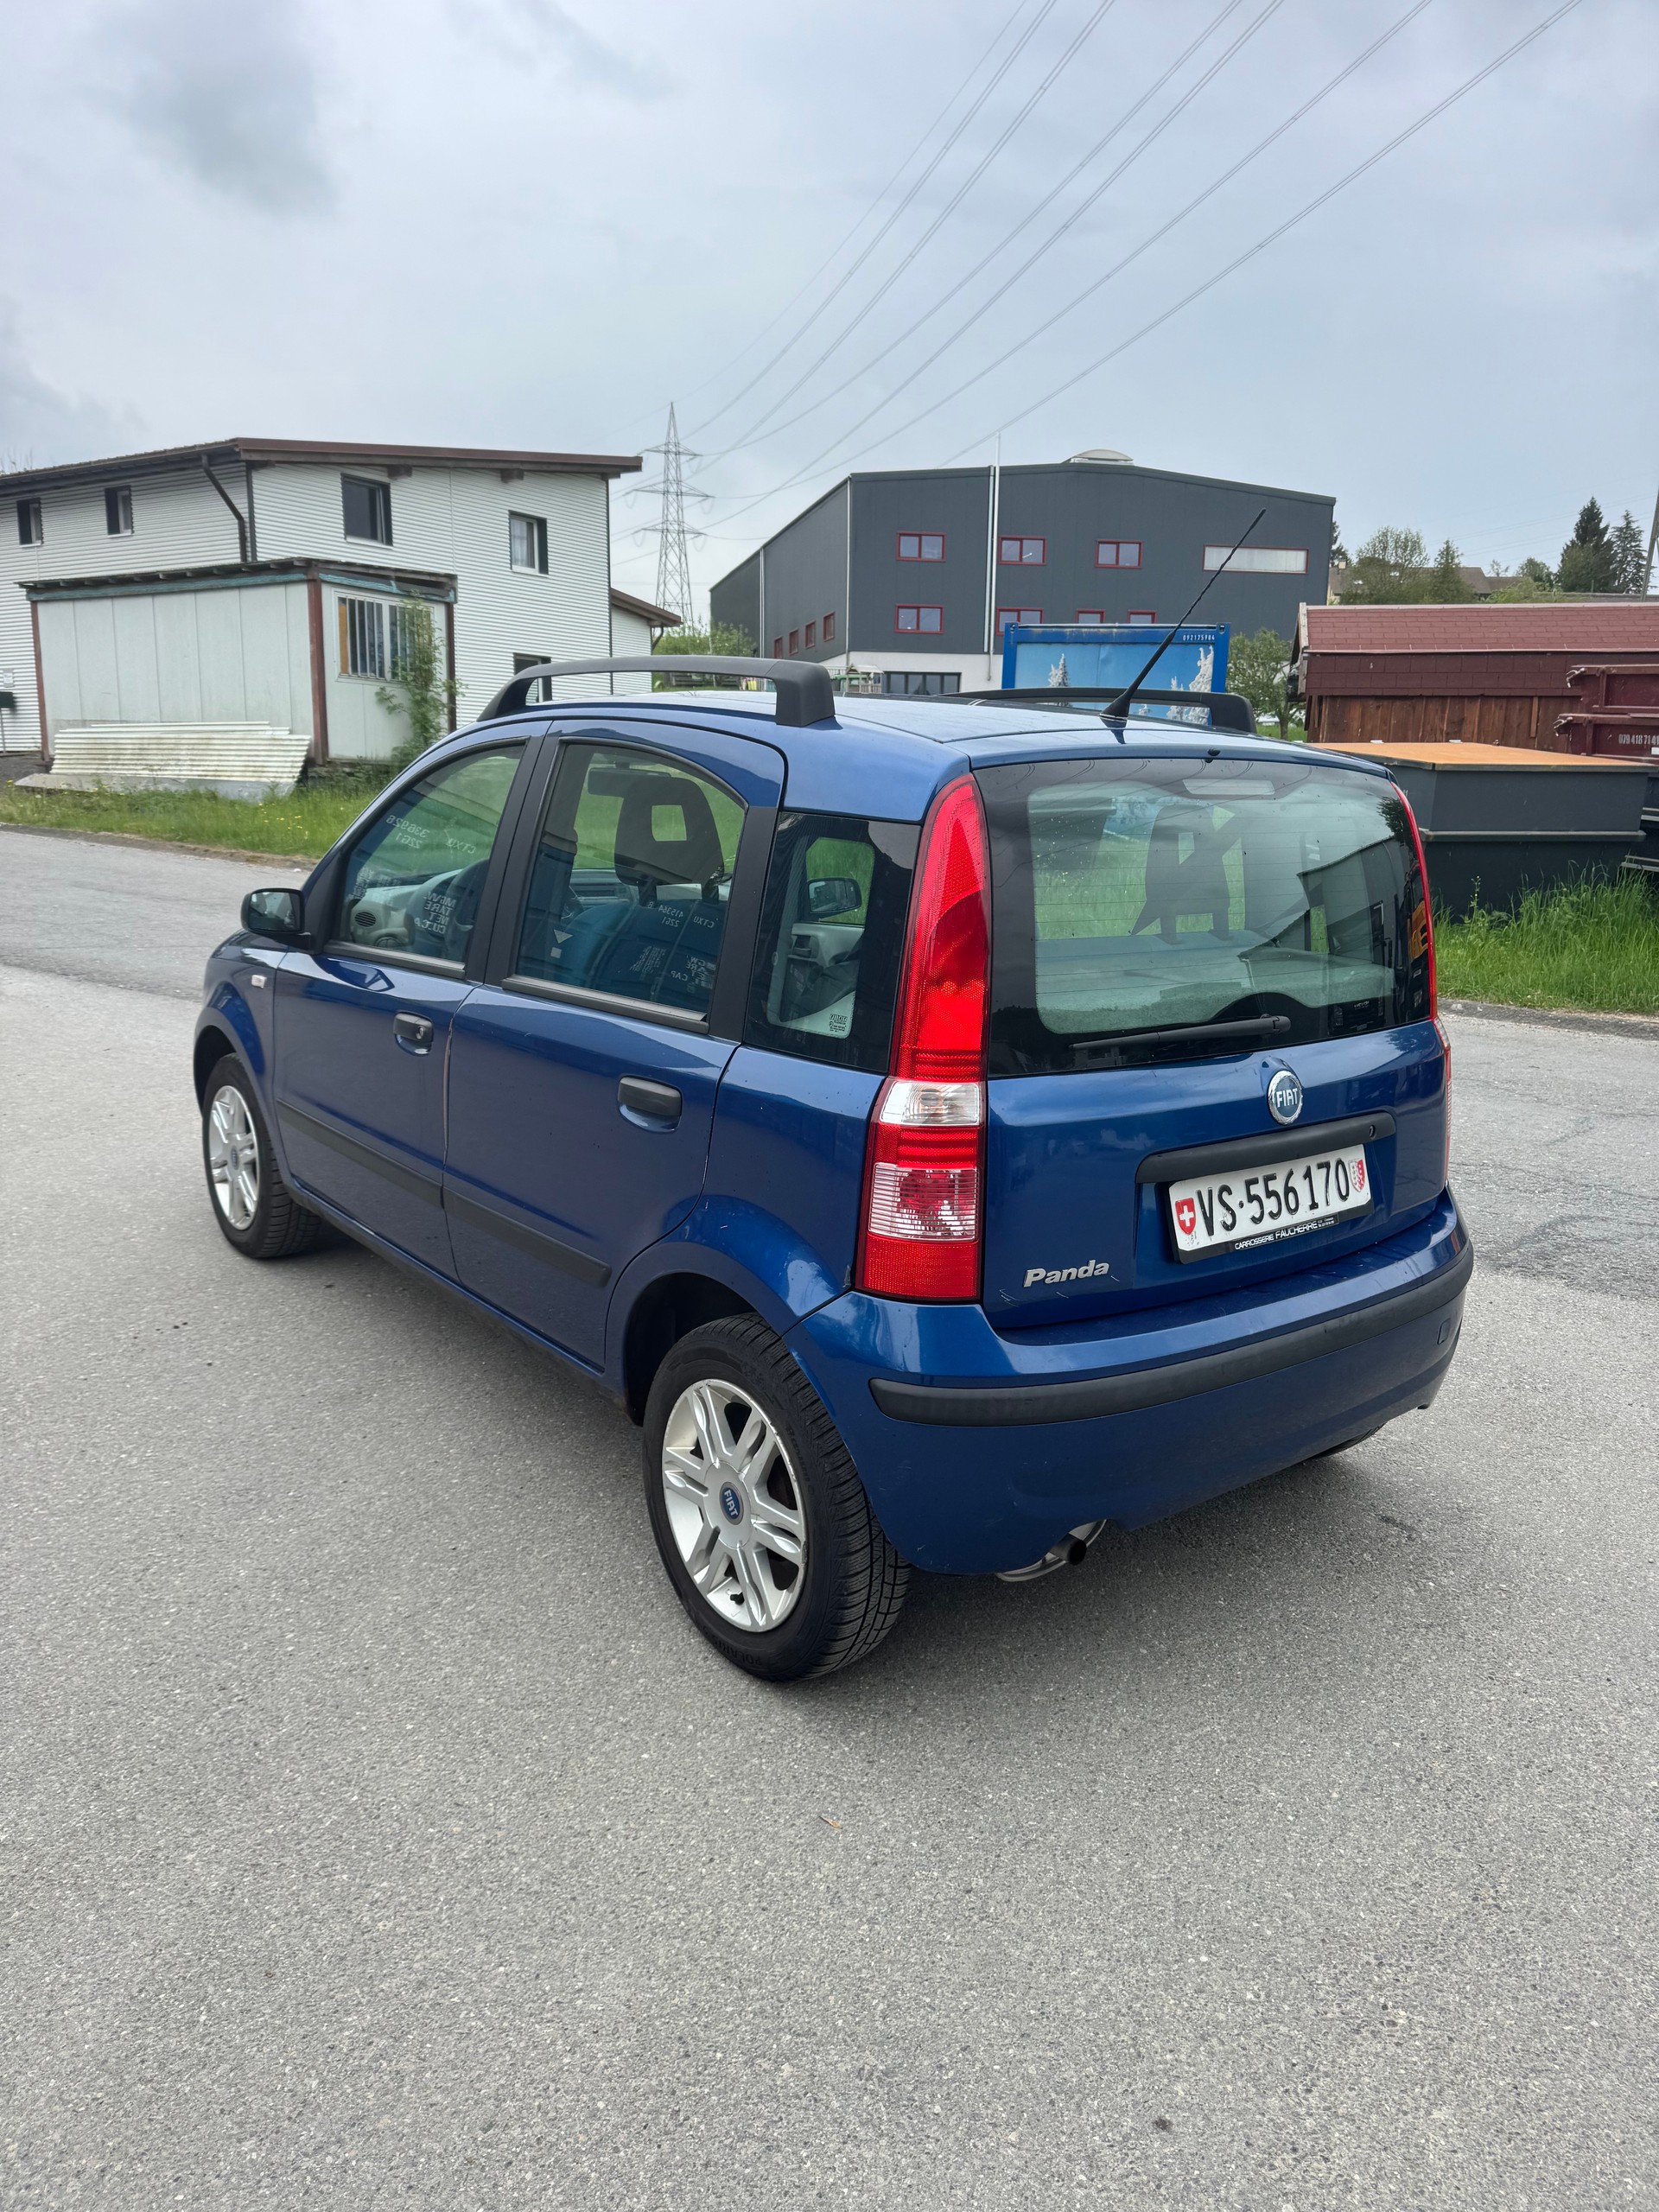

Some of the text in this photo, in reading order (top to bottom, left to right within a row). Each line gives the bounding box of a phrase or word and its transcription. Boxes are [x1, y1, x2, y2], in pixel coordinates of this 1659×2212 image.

[1618, 734, 1630, 744] 079
[1276, 1088, 1298, 1108] FIAT
[1235, 1233, 1274, 1250] CARROSSERIE
[1275, 1221, 1318, 1240] FAUCHERRE
[1023, 1260, 1109, 1287] Panda
[723, 1489, 739, 1517] FIAT
